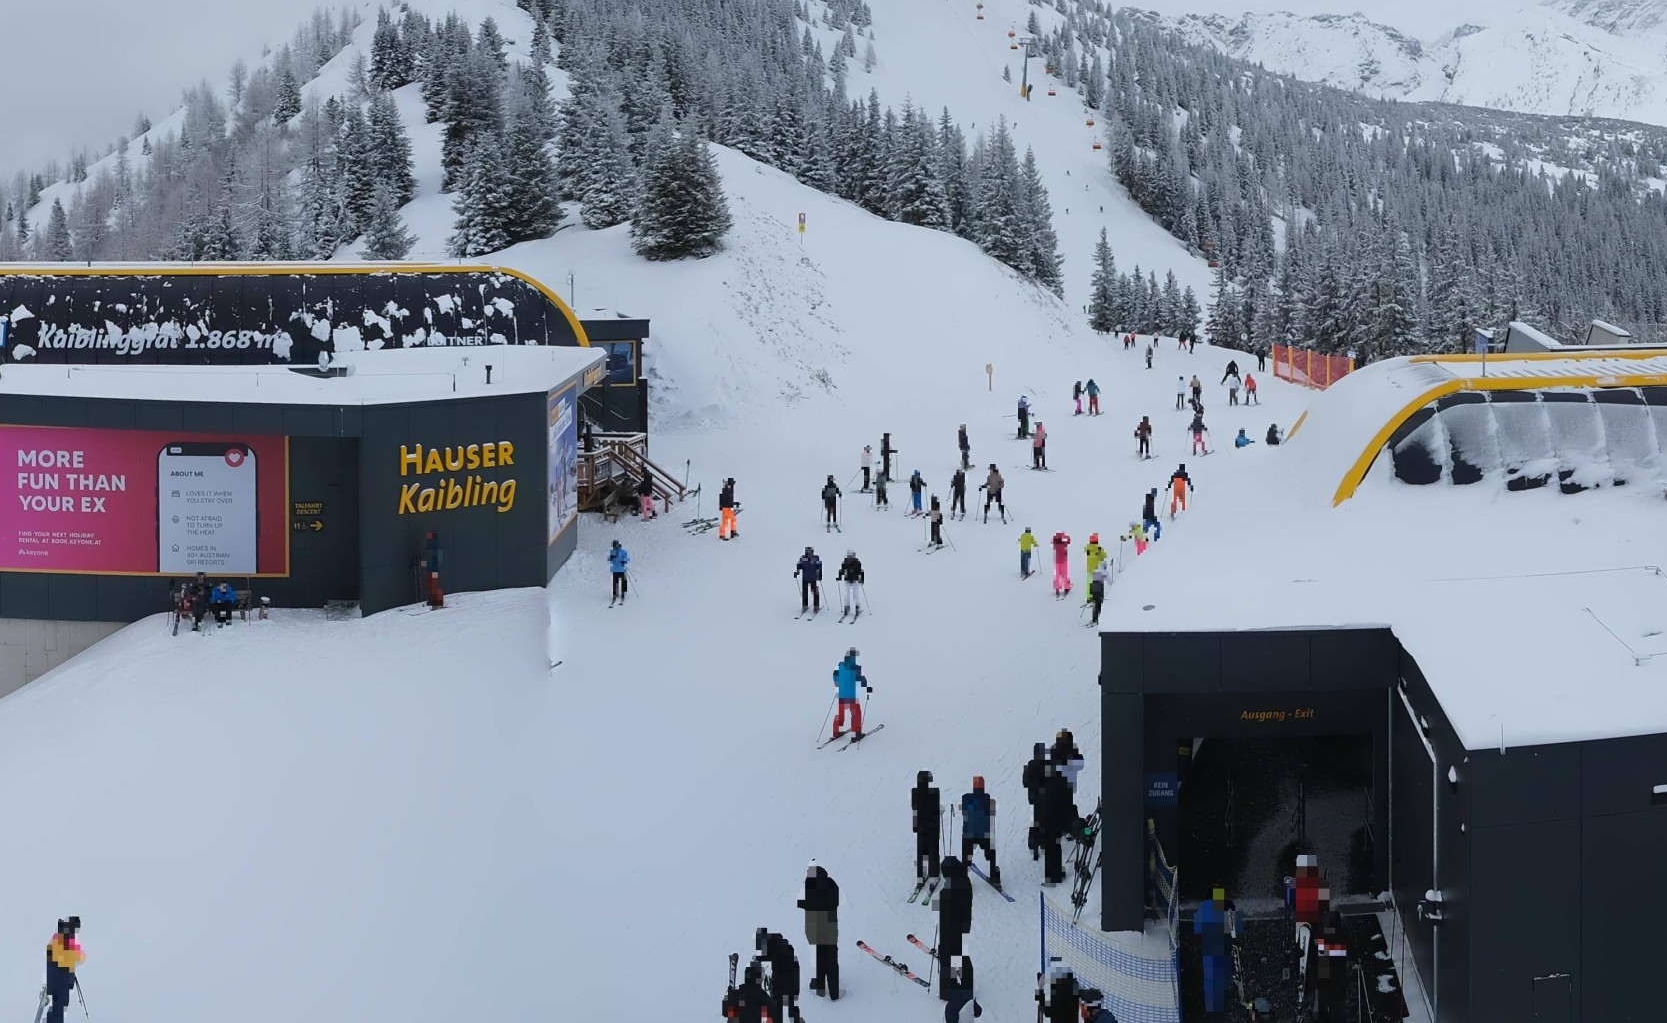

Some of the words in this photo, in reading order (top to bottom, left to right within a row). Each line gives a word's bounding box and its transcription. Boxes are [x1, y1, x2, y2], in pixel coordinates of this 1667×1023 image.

[184, 330, 251, 349] 1.868
[17, 449, 84, 468] MORE
[400, 441, 514, 476] HAUSER
[17, 473, 59, 490] FUN
[66, 474, 126, 491] THAN
[19, 495, 74, 512] YOUR
[81, 497, 106, 513] EX
[398, 475, 517, 515] Kaibling
[1240, 710, 1286, 722] Ausgang
[1295, 708, 1315, 719] Exit
[1148, 789, 1174, 797] ZUGANG
[1153, 781, 1169, 789] KEIN
